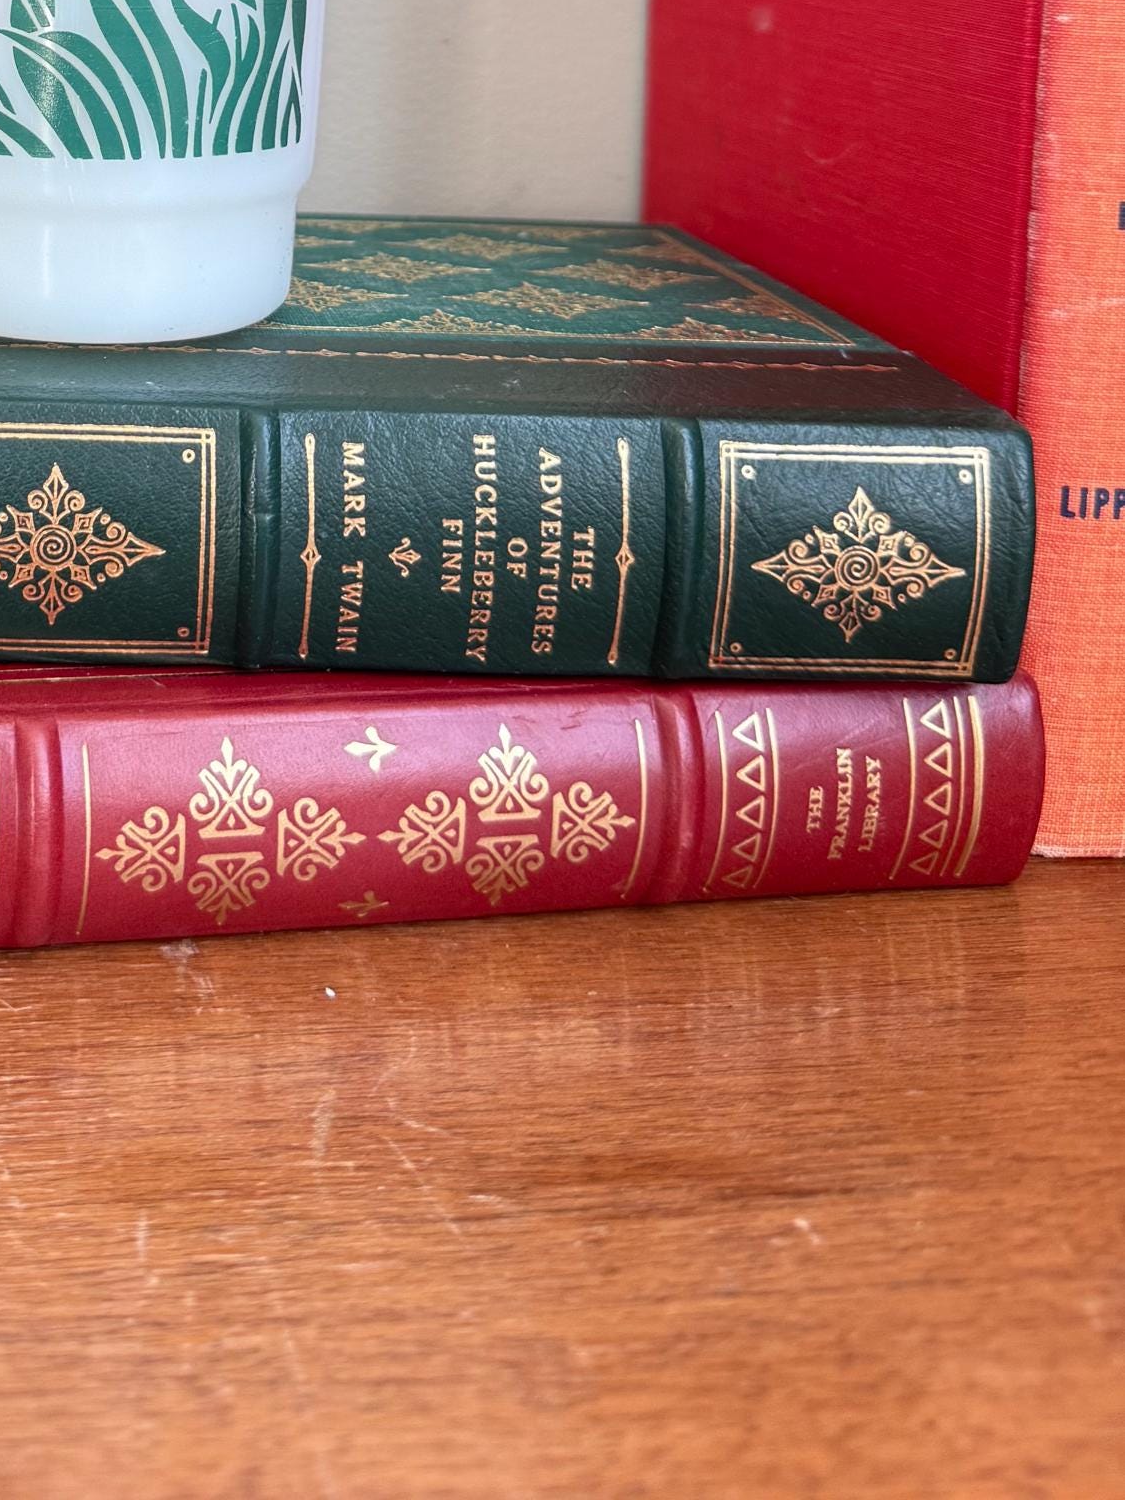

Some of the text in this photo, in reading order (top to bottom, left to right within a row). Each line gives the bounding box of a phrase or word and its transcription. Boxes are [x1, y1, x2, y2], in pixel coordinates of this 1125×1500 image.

[335, 440, 367, 654] MARK TWAIN
[440, 518, 464, 594] FINN
[465, 433, 498, 663] HUCKLEBERRY
[506, 537, 529, 581] OF
[531, 447, 563, 655] ADVENTURES
[571, 525, 596, 591] THE
[806, 785, 824, 834] THE
[827, 747, 854, 860] FRANKLIN
[857, 755, 882, 853] LIBRARY
